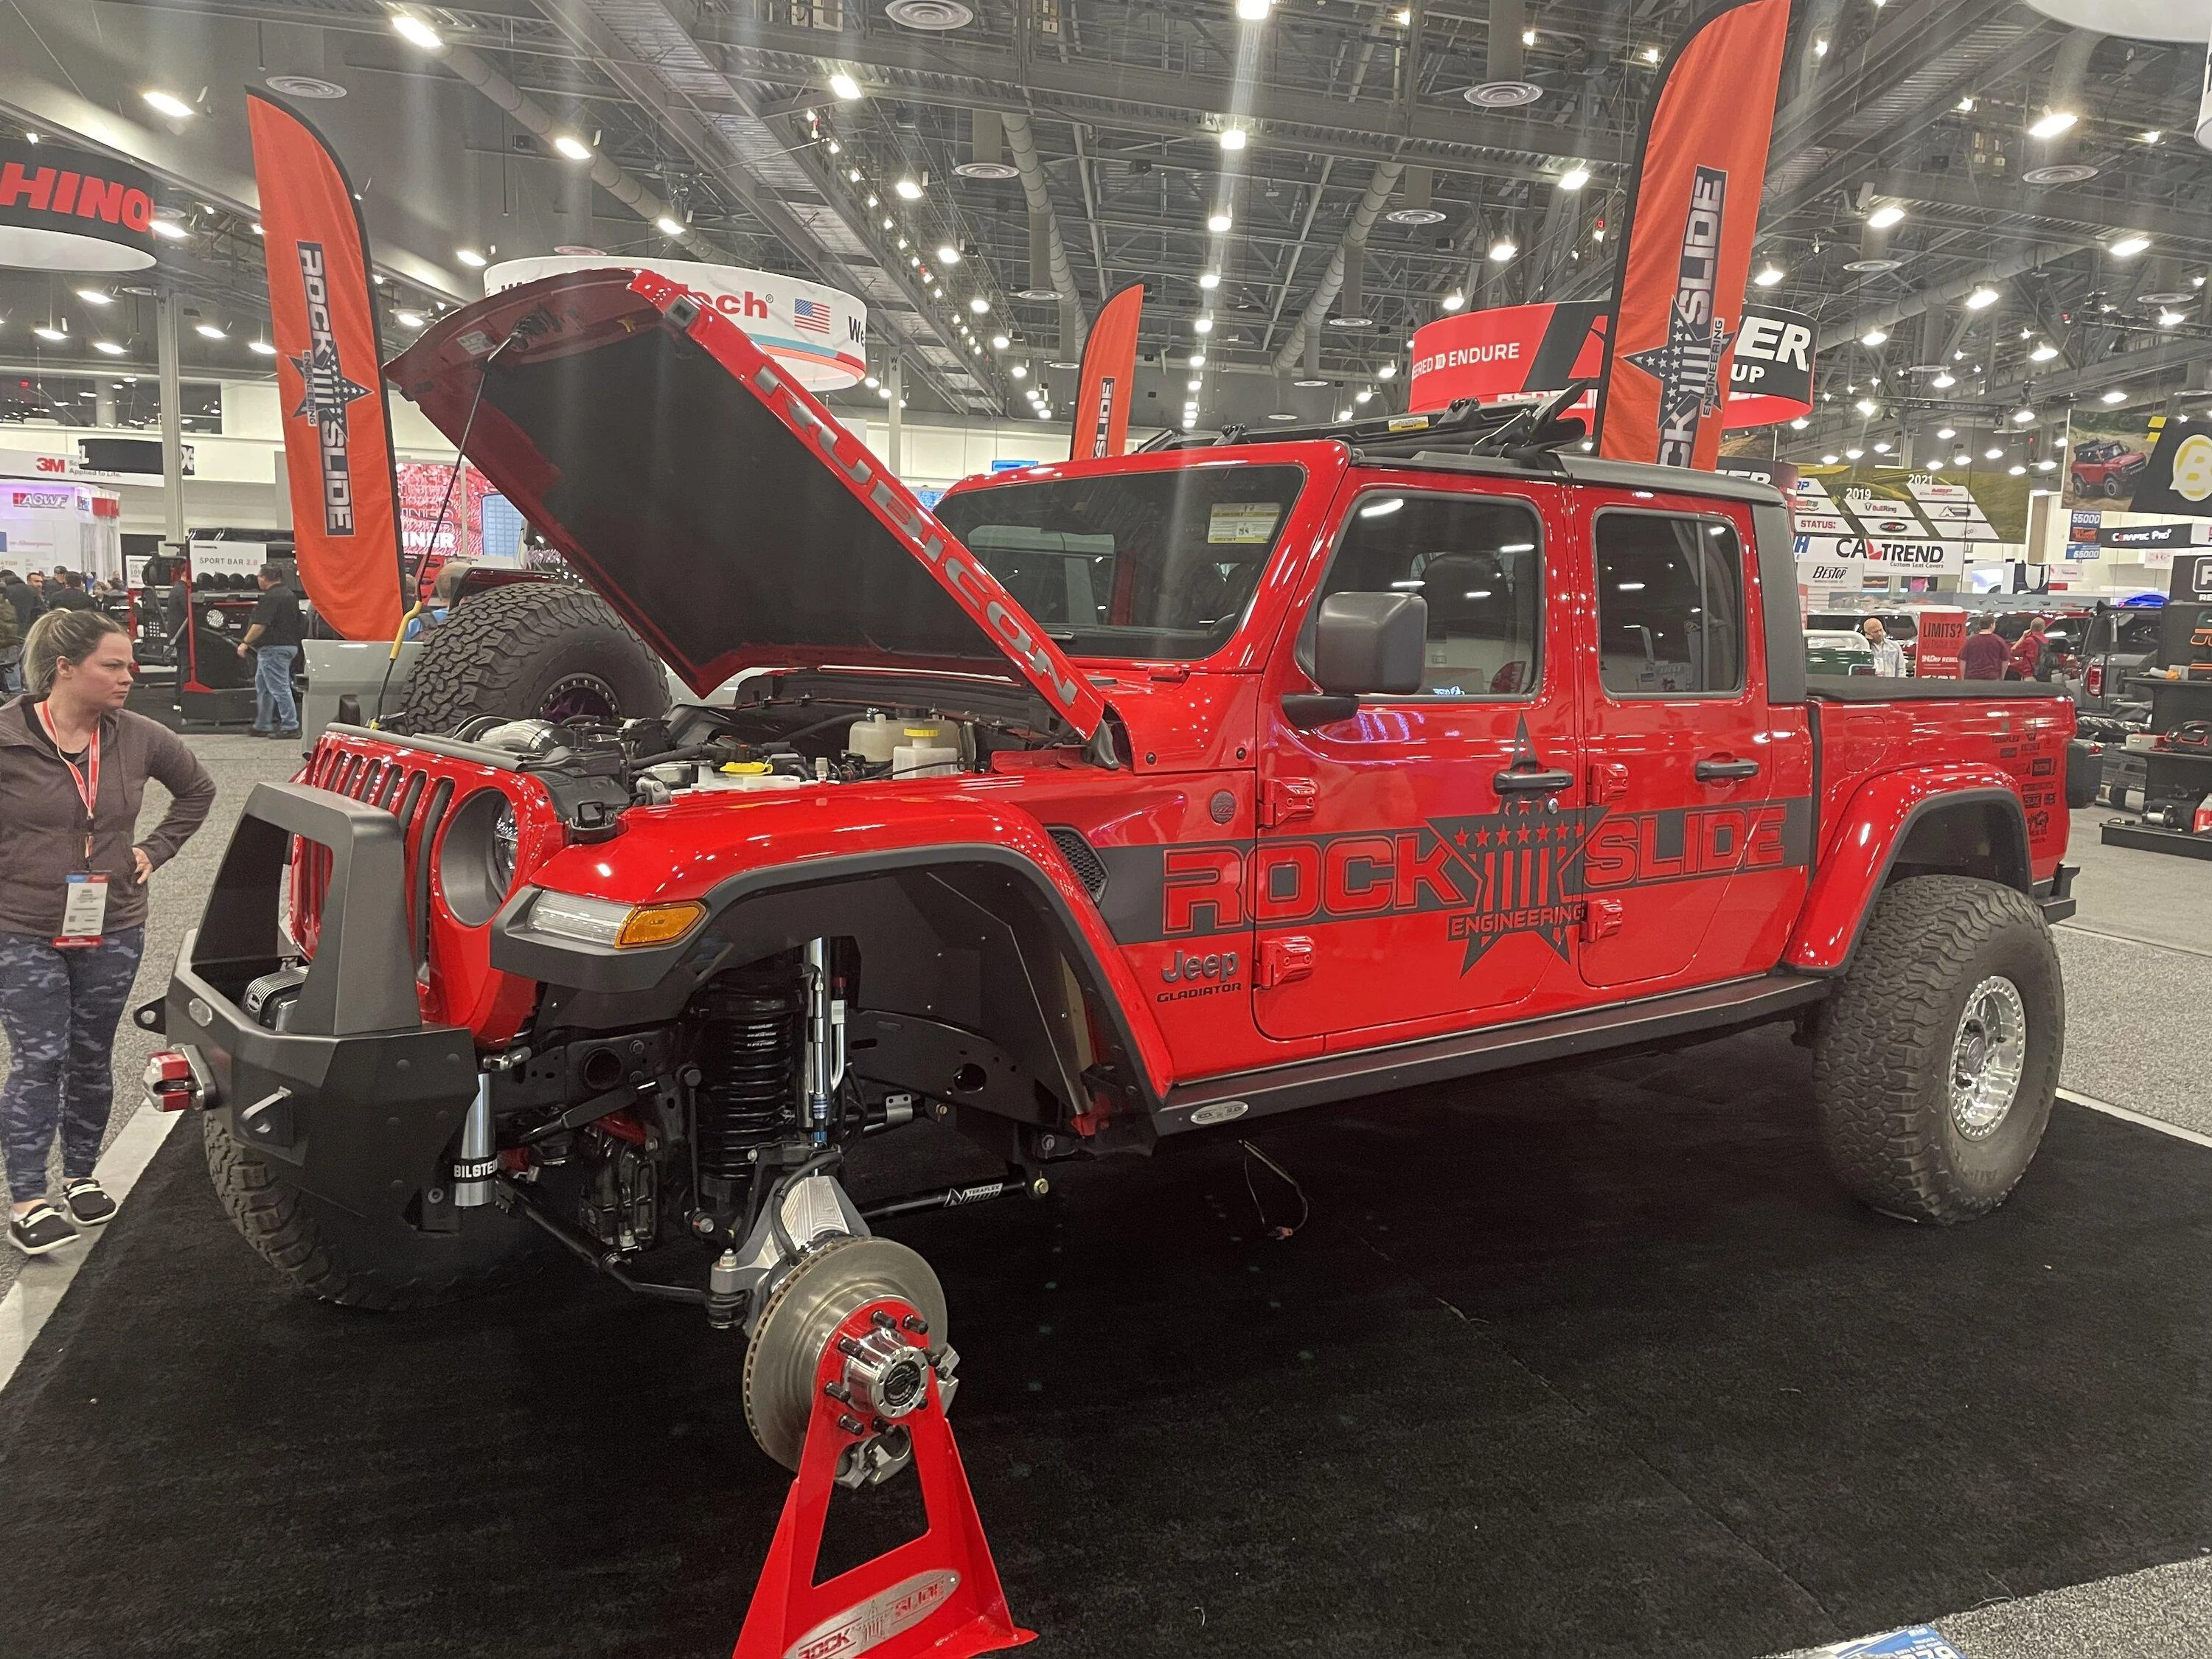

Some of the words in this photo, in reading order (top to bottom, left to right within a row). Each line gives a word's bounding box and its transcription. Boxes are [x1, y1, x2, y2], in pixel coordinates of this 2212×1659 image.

[1678, 175, 1722, 326] SLIDE
[1449, 342, 1520, 367] ENDURE
[1703, 319, 1723, 417] ENGINEERING
[299, 248, 332, 364] ROCK
[324, 419, 352, 529] SLIDE
[304, 351, 316, 425] ENGINEERING
[1094, 382, 1114, 459] SLIDE
[36, 456, 65, 473] 3M
[1908, 473, 1933, 485] 2021
[1845, 487, 1871, 501] 2019
[2072, 513, 2101, 524] 55000
[753, 365, 1079, 709] RUBICON
[199, 557, 225, 565] SPORT
[2073, 550, 2100, 559] 65000
[1923, 622, 1962, 639] LIMITS?
[1163, 832, 1467, 935] ROCK
[1584, 803, 1787, 888] SLIDE
[1451, 902, 1585, 936] ENGINEERING
[1161, 950, 1239, 983] Jeep
[1156, 982, 1242, 1003] GLADIATOR
